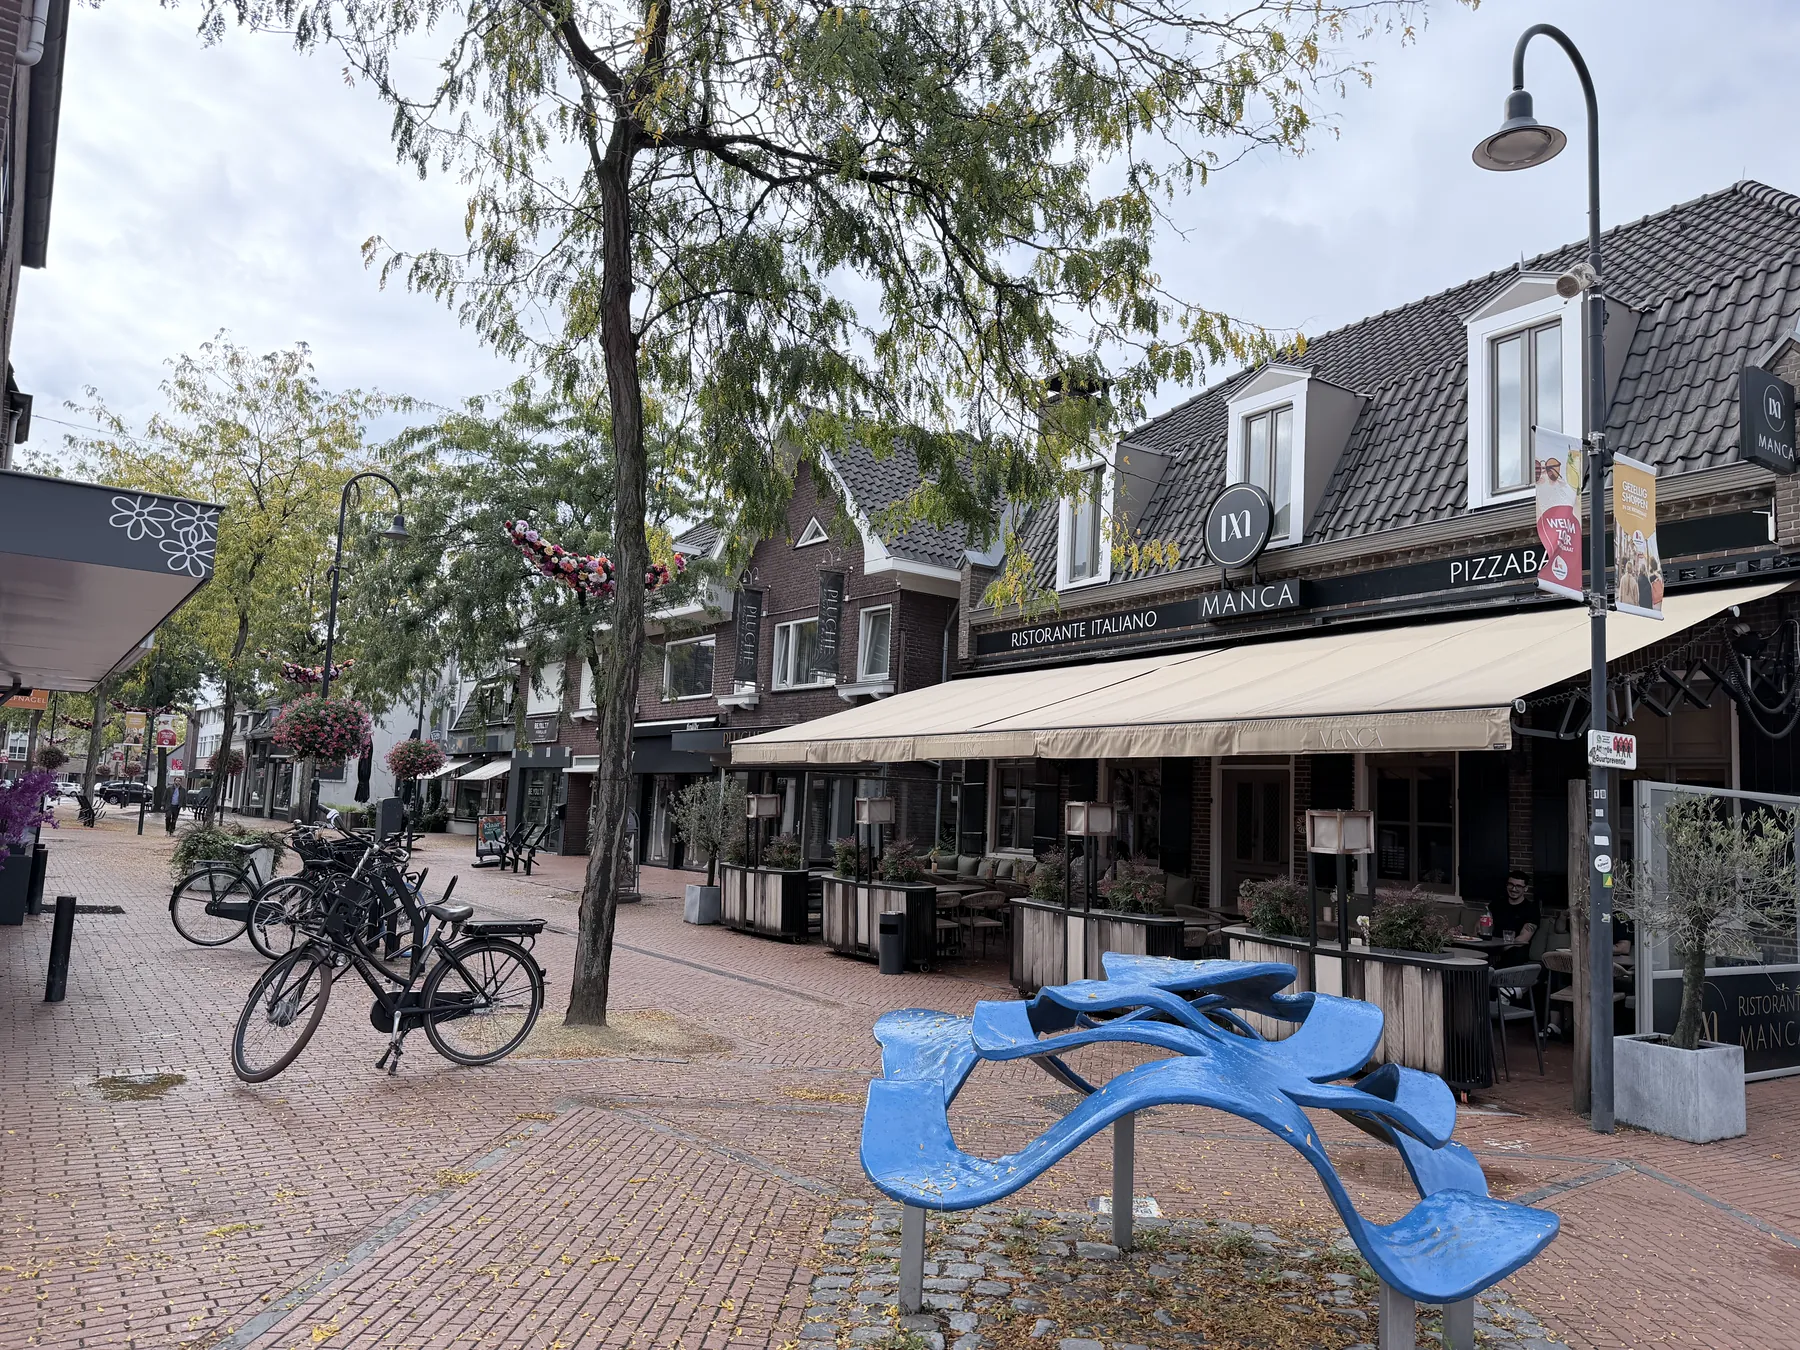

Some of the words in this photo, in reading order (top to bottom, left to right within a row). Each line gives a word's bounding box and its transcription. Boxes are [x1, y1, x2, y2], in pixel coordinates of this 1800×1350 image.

[1758, 433, 1795, 462] MANCA
[1621, 491, 1648, 510] SHOPPEN
[1546, 517, 1576, 534] WELM
[1450, 550, 1550, 584] PIZZABA
[1201, 583, 1294, 618] MANCA
[743, 605, 758, 666] PLUCHE
[823, 588, 840, 655] PLUCHE
[1011, 621, 1086, 648] RISTORANTE
[1091, 610, 1158, 636] ITALIANO
[1318, 727, 1384, 749] MANCA
[1738, 993, 1800, 1017] RISTORANT
[1740, 1020, 1800, 1052] MANC
